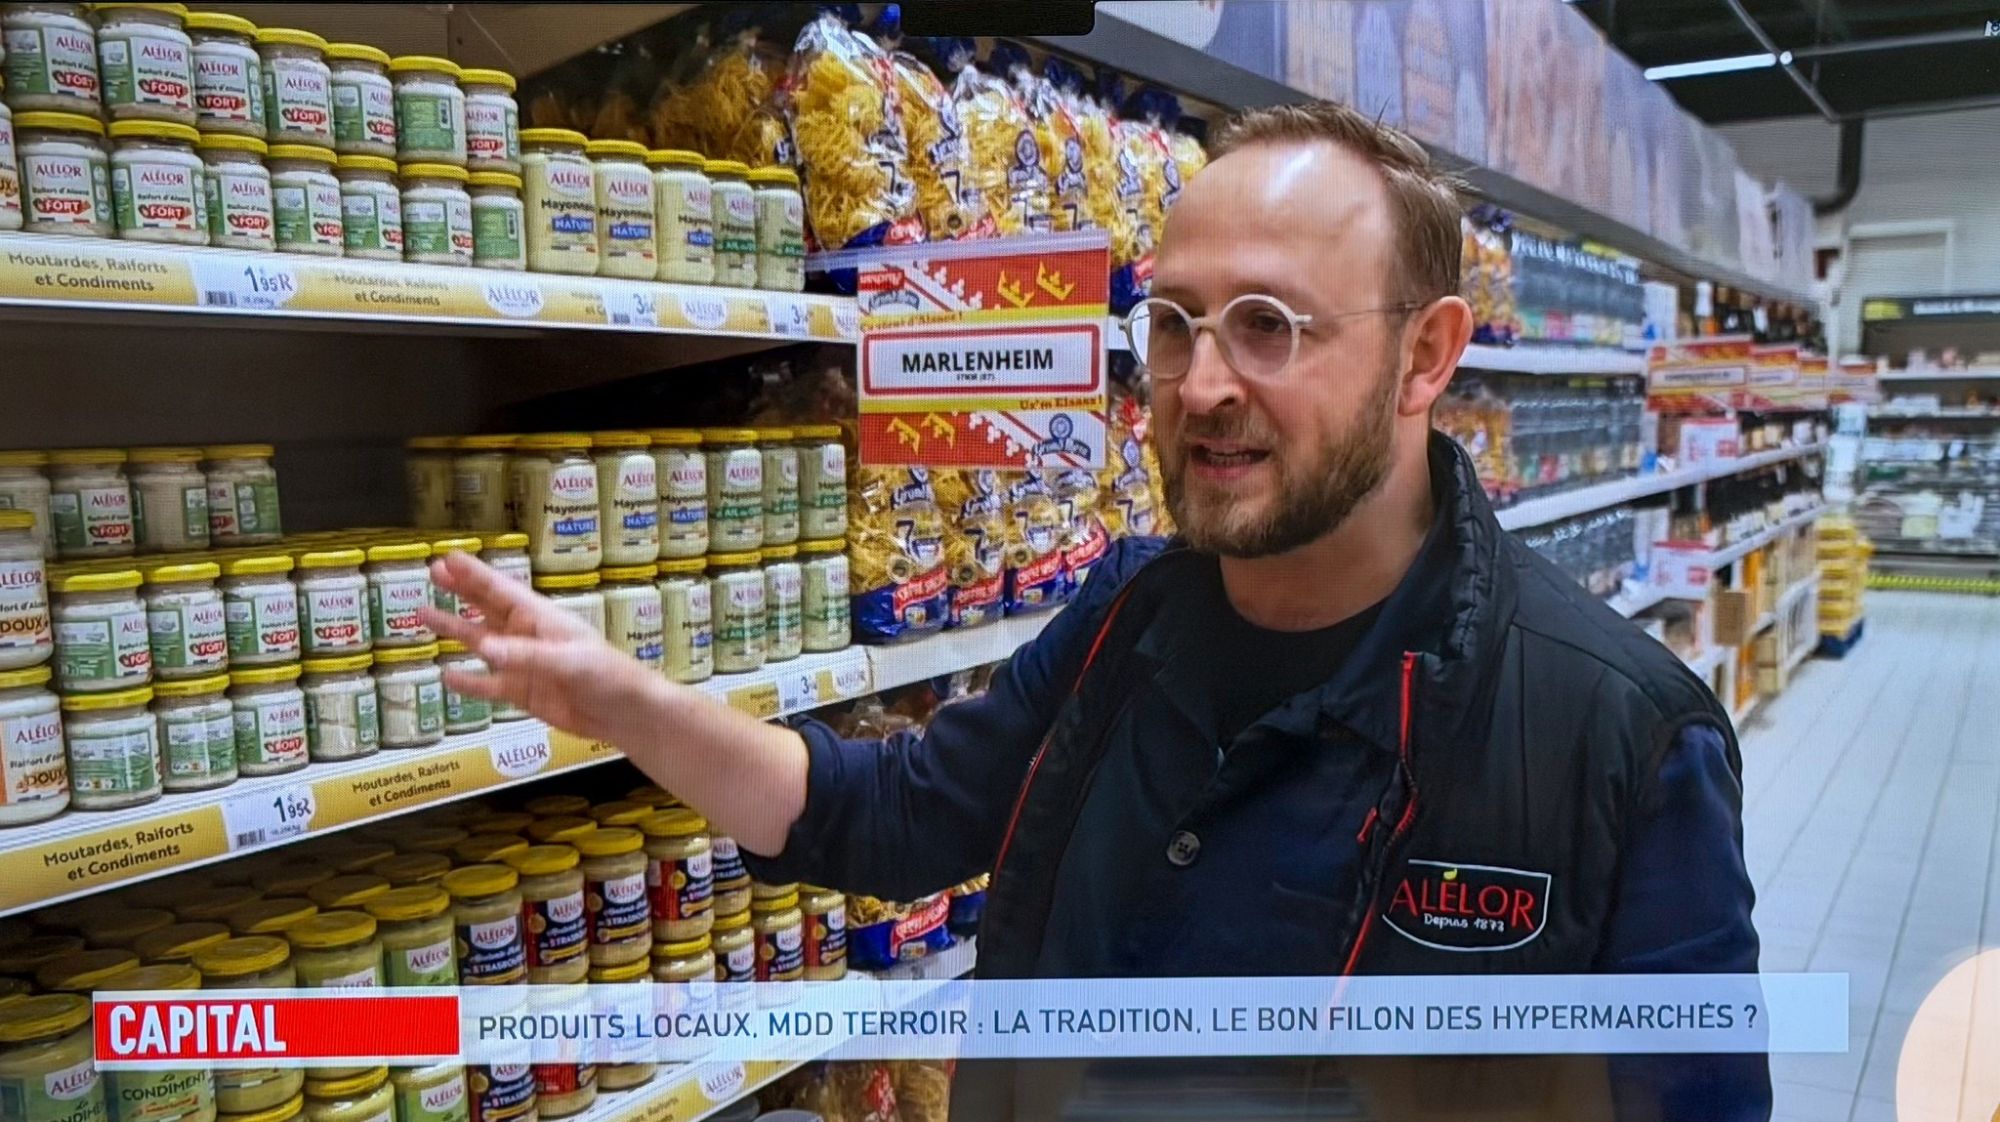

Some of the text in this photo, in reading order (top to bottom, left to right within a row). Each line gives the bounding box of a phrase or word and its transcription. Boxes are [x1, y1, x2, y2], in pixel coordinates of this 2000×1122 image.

[66, 73, 95, 88] FORT
[151, 82, 182, 97] FORT
[206, 97, 236, 109] FORT
[293, 111, 320, 122] FORT
[471, 140, 495, 149] FORT
[46, 200, 79, 212] FORT
[151, 206, 182, 218] FORT
[239, 214, 264, 226] FORT
[8, 252, 168, 274] Moutardes, Raiforts
[35, 273, 155, 292] et Condiments
[902, 349, 1054, 373] MARLENHEIM
[1, 616, 42, 632] DOUX
[272, 630, 297, 644] FORT
[325, 627, 351, 638] FORT
[26, 770, 65, 787] DOUX
[353, 760, 461, 793] Moutardes, Raiforts
[369, 779, 452, 807] et Condiments
[44, 821, 194, 868] Moutardes, Raiforts
[67, 843, 181, 881] et Condiments
[1423, 912, 1468, 930] Depuis
[122, 1071, 207, 1102] CONDIMENT
